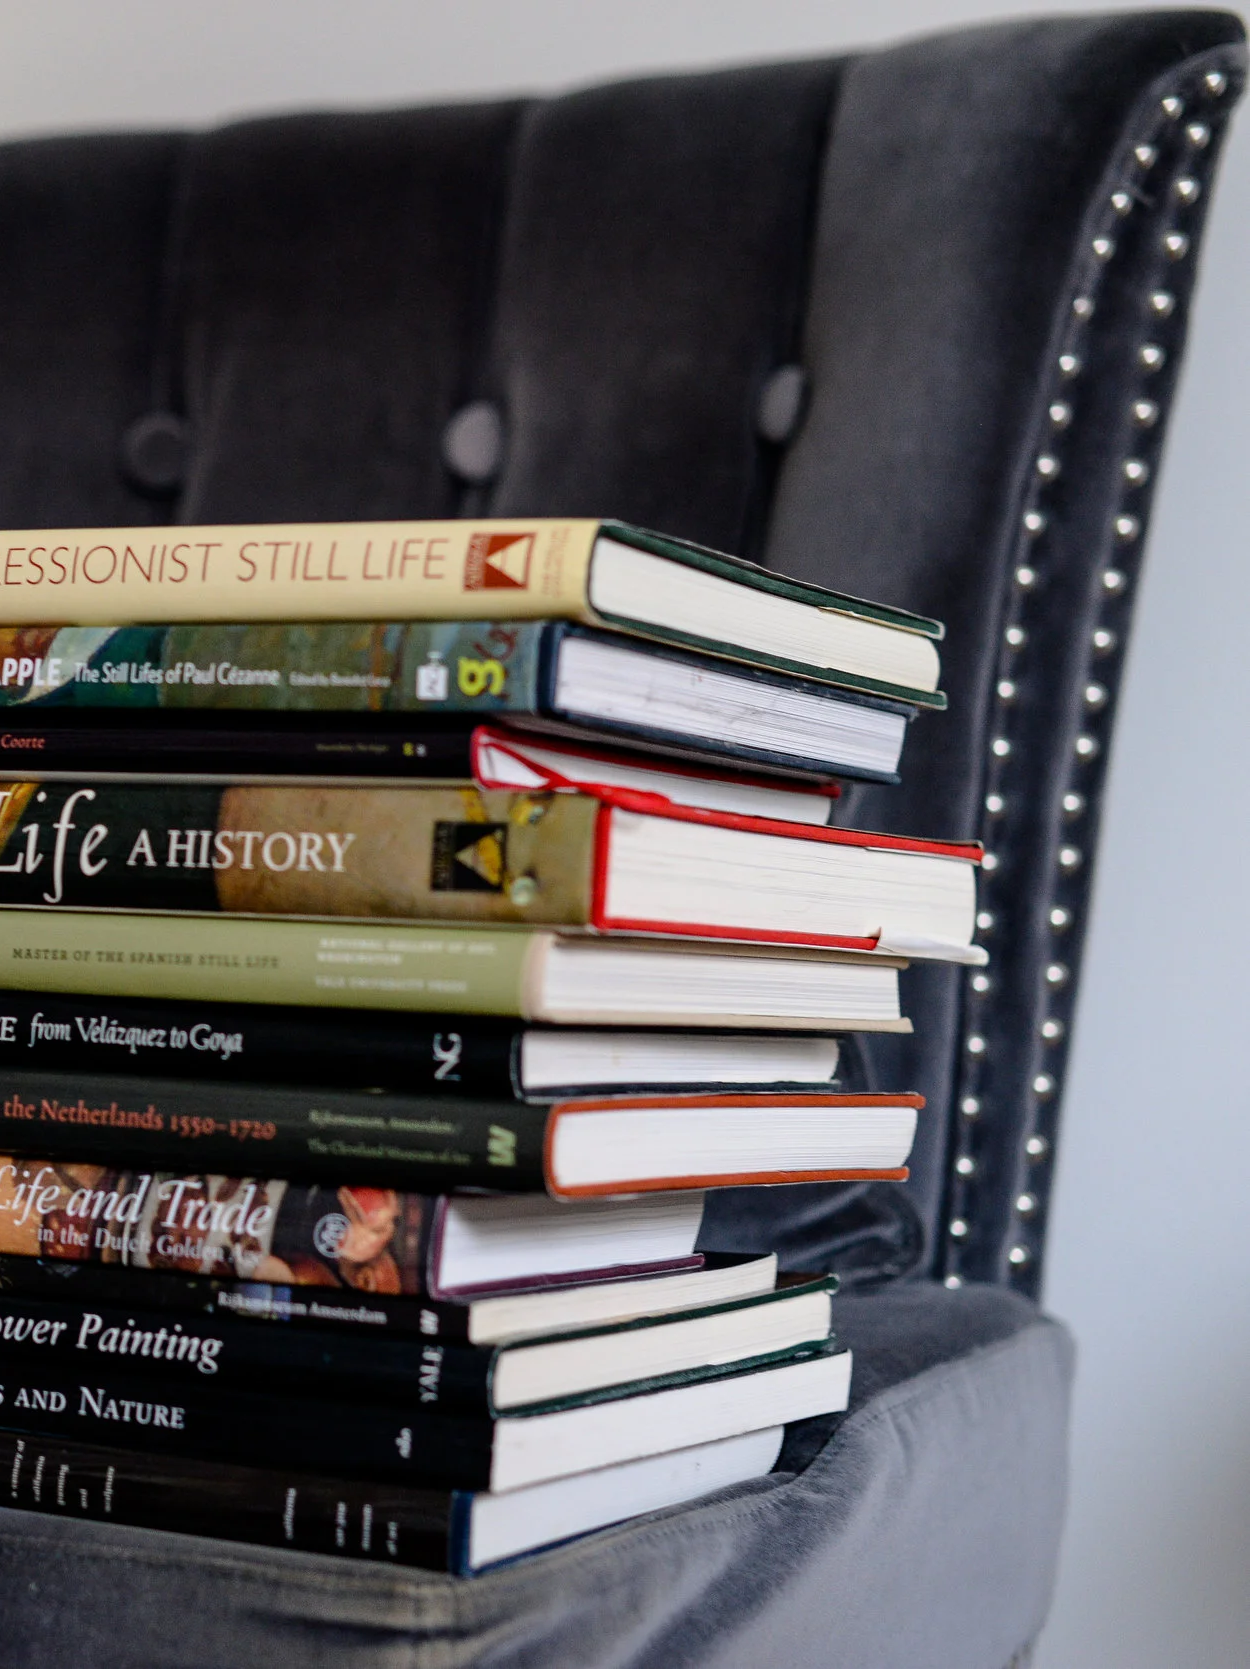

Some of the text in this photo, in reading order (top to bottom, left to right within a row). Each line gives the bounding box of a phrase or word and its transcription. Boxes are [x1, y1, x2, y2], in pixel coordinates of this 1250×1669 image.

[237, 541, 348, 582] STILL
[362, 538, 451, 581] LIFE
[73, 661, 100, 684] The
[102, 661, 129, 684] Still
[131, 662, 163, 684] Lifes
[165, 663, 182, 684] of
[183, 663, 214, 685] Paul
[216, 663, 280, 687] Cézanne
[0, 734, 46, 749] Coorte
[127, 829, 157, 867] A
[165, 829, 357, 873] HISTORY
[12, 948, 68, 961] MASTER
[73, 950, 92, 962] OF
[97, 951, 124, 963] THE
[129, 953, 192, 966] SPANISH
[27, 1012, 72, 1048] from
[75, 1016, 166, 1055] Velázquez
[170, 1026, 188, 1049] to
[189, 1023, 244, 1061] Goya
[3, 1094, 36, 1119] the
[39, 1099, 164, 1131] Netherlands
[66, 1174, 152, 1224] and
[159, 1178, 274, 1238] Trade
[37, 1224, 223, 1262] in the Dutch Golden
[75, 1312, 224, 1375] Painting
[13, 1387, 67, 1412] AND
[77, 1385, 187, 1430] NATURE
